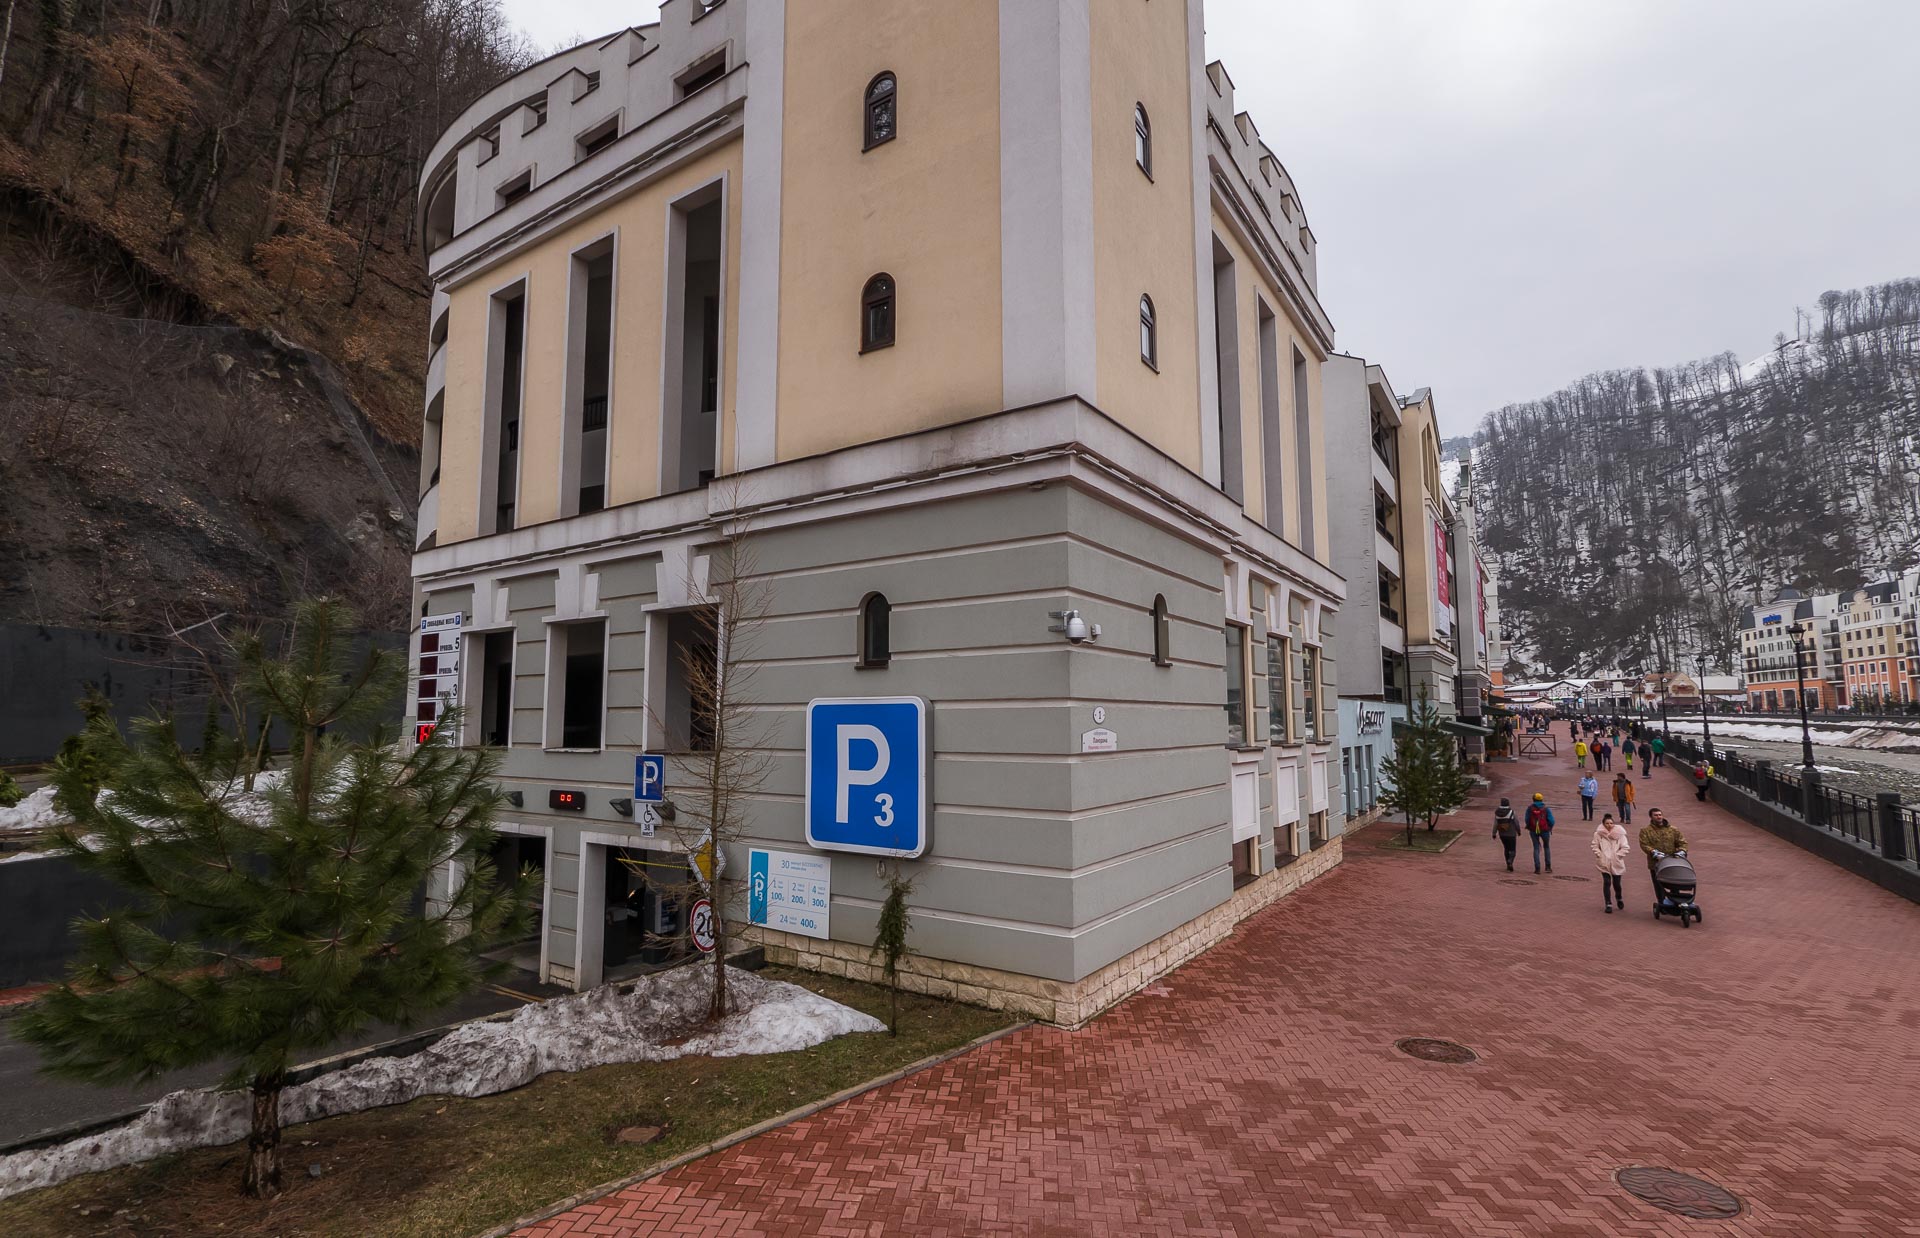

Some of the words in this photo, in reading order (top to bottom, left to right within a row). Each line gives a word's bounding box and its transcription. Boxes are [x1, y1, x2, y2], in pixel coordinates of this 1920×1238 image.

[455, 637, 459, 649] 5
[454, 660, 458, 673] 4
[453, 684, 457, 696] 3
[1098, 711, 1101, 719] 1
[1365, 711, 1385, 728] SCOTT
[643, 761, 658, 795] P
[781, 860, 789, 869] 30
[792, 883, 796, 891] 2
[812, 886, 817, 894] 4
[780, 915, 788, 923] 24
